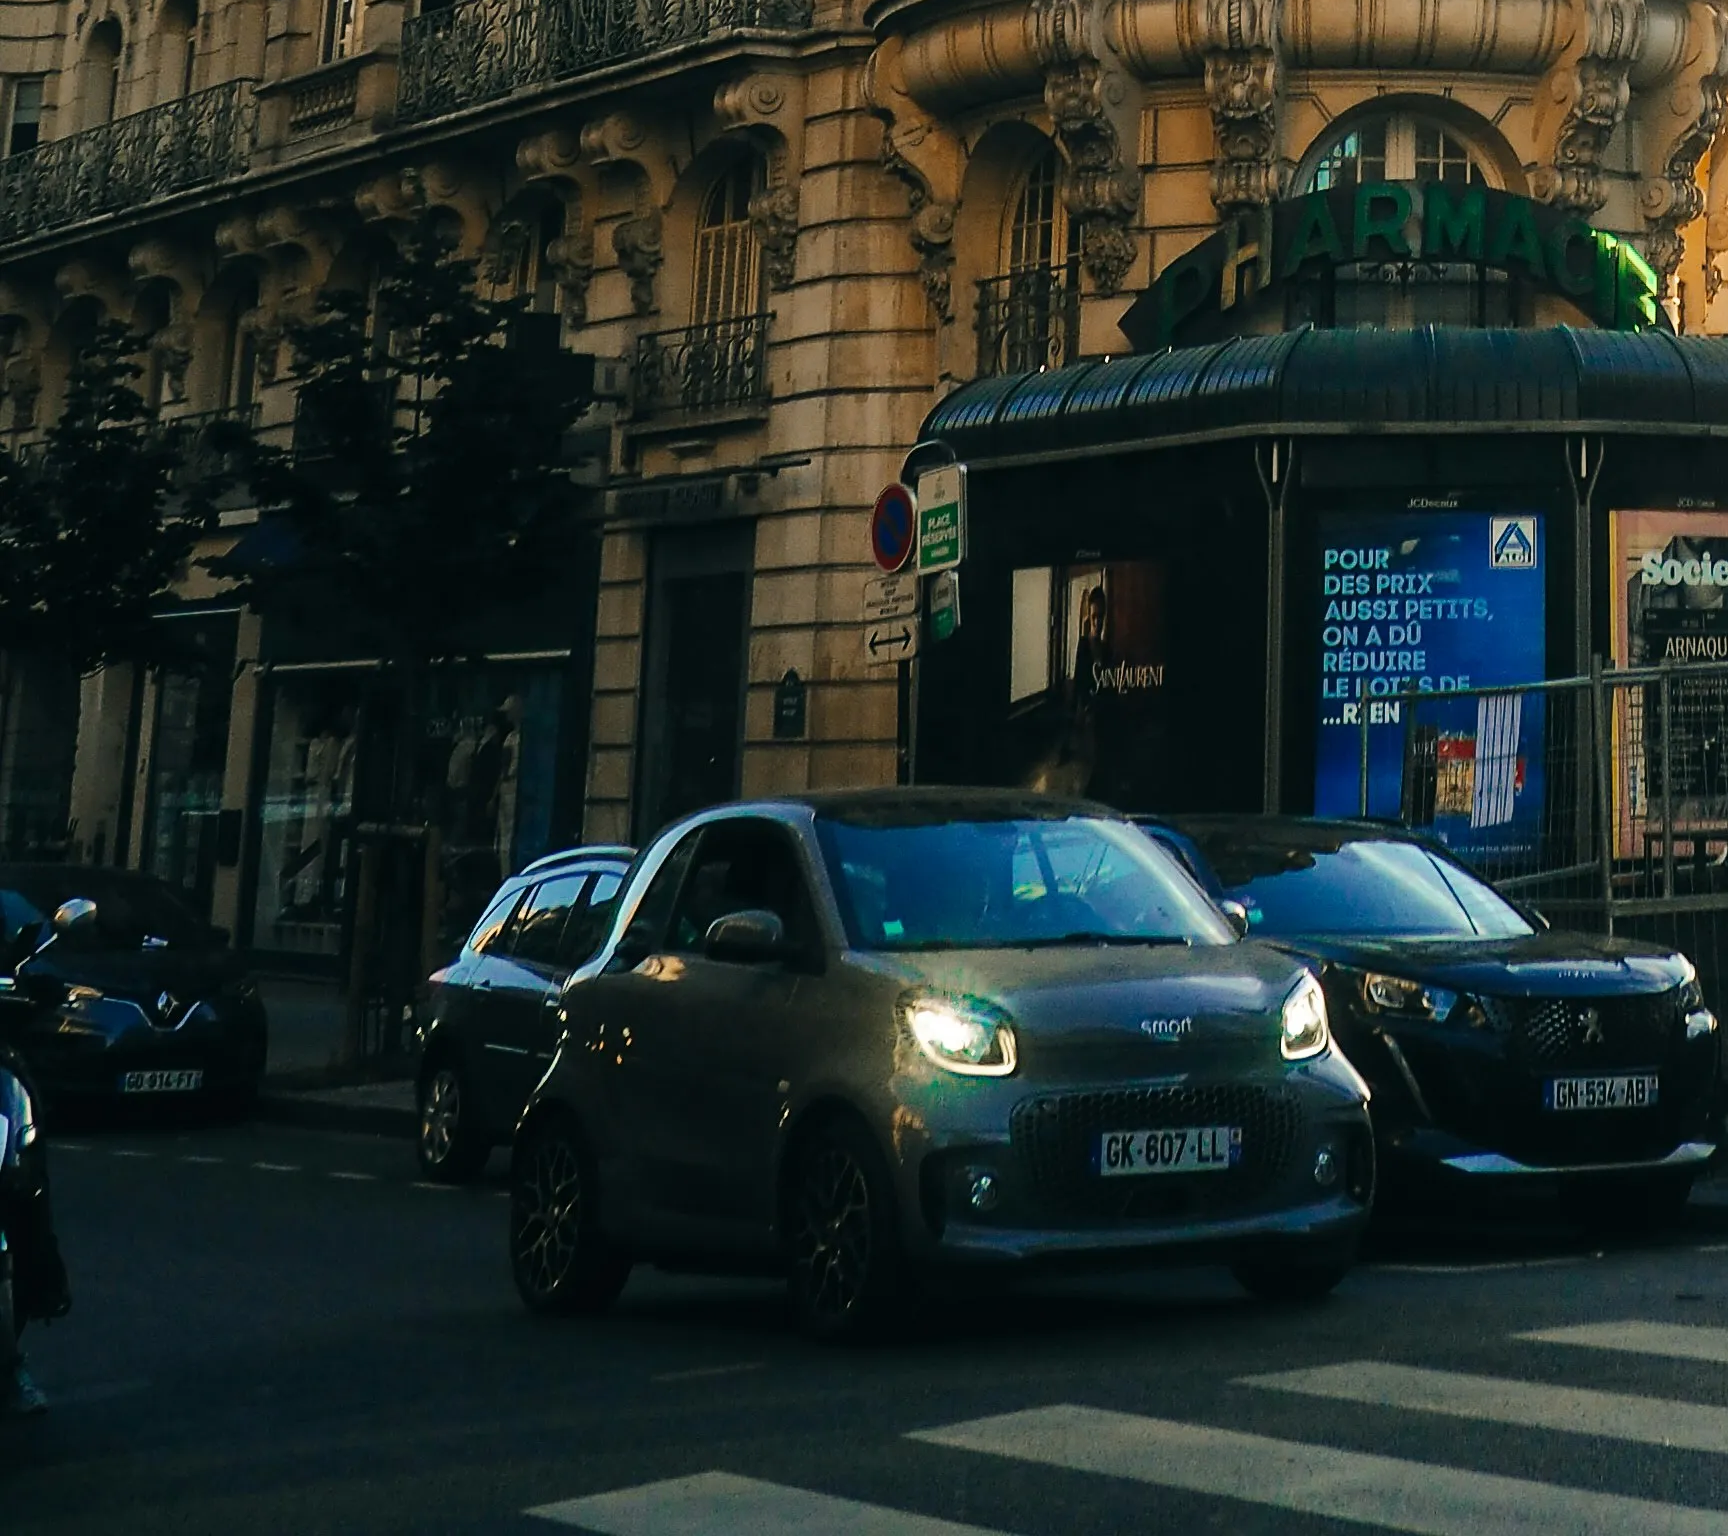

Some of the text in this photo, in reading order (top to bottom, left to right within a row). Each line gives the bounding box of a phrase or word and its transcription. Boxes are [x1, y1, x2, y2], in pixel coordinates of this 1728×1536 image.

[1160, 181, 1658, 345] PHARMACIE
[1324, 549, 1390, 570] POUR
[1324, 573, 1433, 595] DES PRIX
[1324, 598, 1494, 622] AUSSI PETITS,
[1322, 620, 1422, 646] ON A DÛ
[1323, 648, 1426, 672] RÉDUIRE
[1323, 678, 1349, 699] LE
[1440, 676, 1470, 692] DE
[1141, 1016, 1192, 1035] smart
[1106, 1128, 1224, 1169] GK-607-LL
